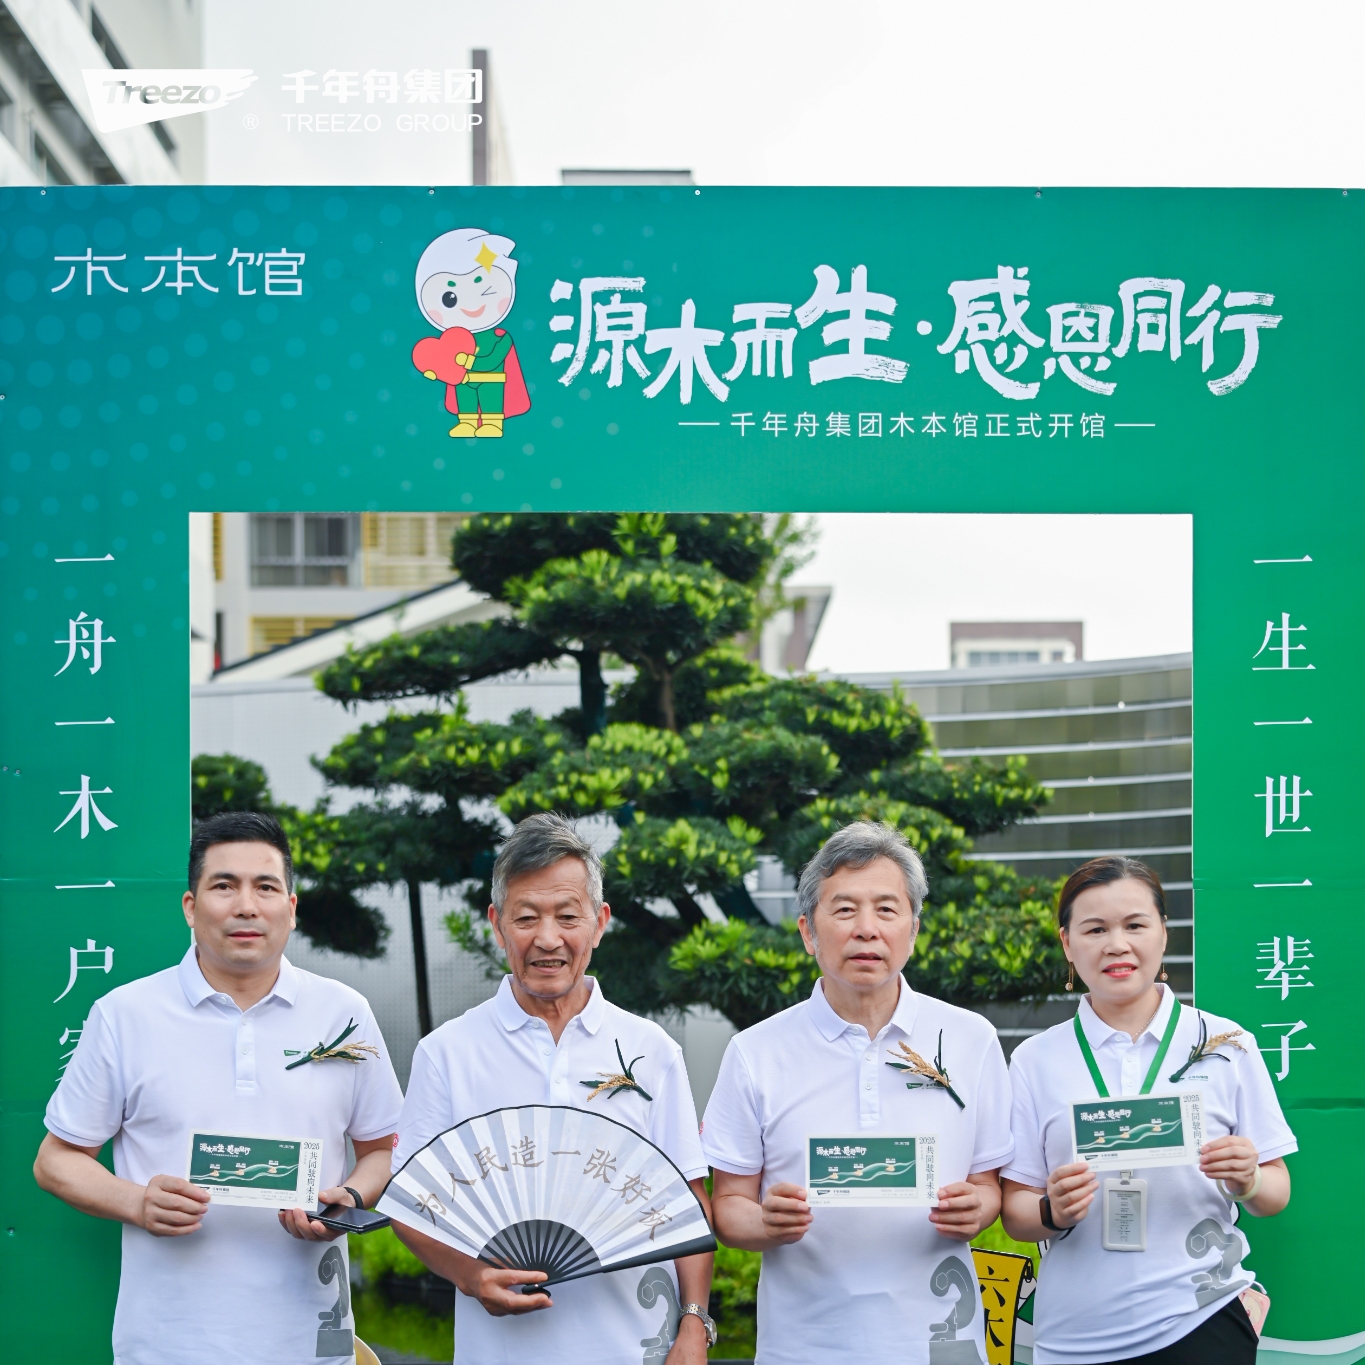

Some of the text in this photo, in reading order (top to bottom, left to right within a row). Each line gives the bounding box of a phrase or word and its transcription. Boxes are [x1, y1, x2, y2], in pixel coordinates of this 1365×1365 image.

[51, 247, 306, 297] 木本馆
[549, 265, 1283, 404] 源木而生·感恩同行
[730, 412, 1107, 438] 千年舟集团木本馆正式开馆
[1252, 553, 1316, 1082] 一生一世一辈子
[414, 1134, 674, 1242] 为人民造一张好板
